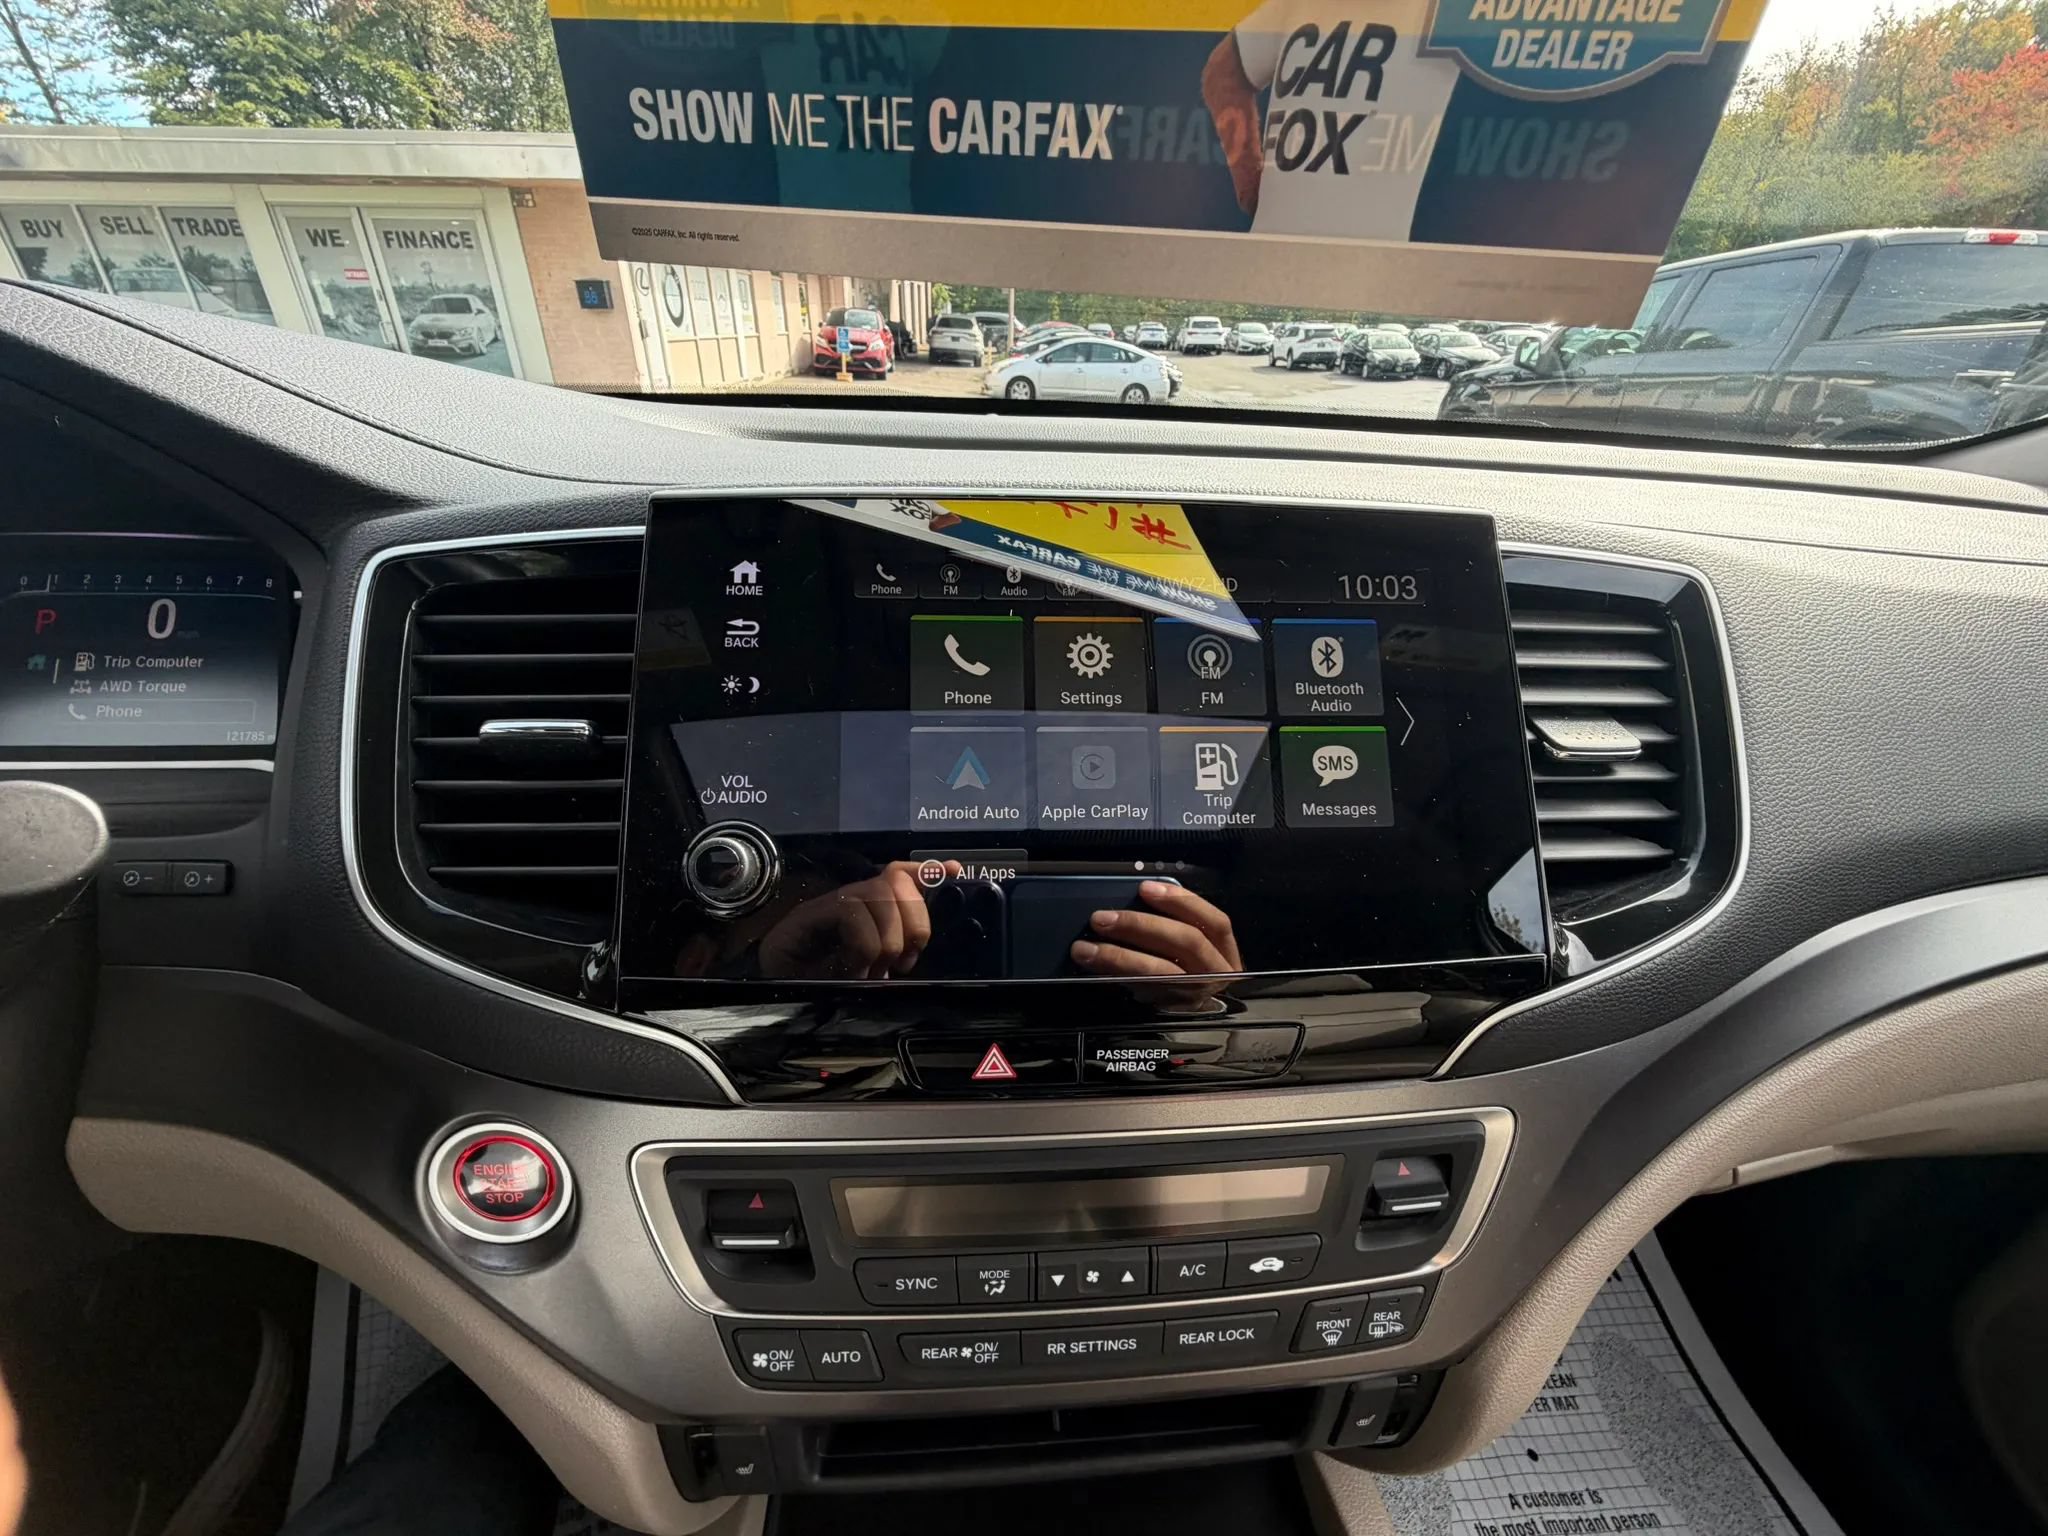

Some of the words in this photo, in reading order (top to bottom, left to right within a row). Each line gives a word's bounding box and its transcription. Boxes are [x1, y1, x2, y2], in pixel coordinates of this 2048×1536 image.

[1469, 0, 1684, 23] ADVANTAGE
[1492, 28, 1634, 71] DEALER
[1276, 21, 1396, 102] CAR
[629, 87, 753, 144] SHOW
[768, 92, 828, 149] ME
[837, 95, 915, 152] THE
[928, 97, 1115, 161] CARFAX
[1262, 110, 1366, 176] FOX
[20, 219, 64, 239] BUY
[100, 216, 154, 236] SELL
[171, 217, 244, 238] TRADE
[305, 228, 345, 248] WE
[382, 230, 474, 250] FINANCE
[20, 576, 28, 586] 0
[83, 574, 91, 584] 2
[115, 574, 122, 584] 3
[145, 575, 152, 584] 4
[176, 575, 183, 585] 5
[206, 576, 213, 585] 6
[236, 576, 243, 585] 7
[265, 578, 273, 588] 8
[1337, 574, 1418, 600] 10:03
[725, 585, 763, 596] HOME
[871, 584, 902, 595] Phone
[943, 585, 958, 595] FM
[1000, 586, 1028, 597] Audio
[35, 608, 57, 634] P
[147, 598, 177, 639] 0
[724, 637, 759, 648] BACK
[103, 655, 131, 669] Trip
[135, 655, 204, 669] Computer
[1200, 666, 1221, 680] FM
[100, 681, 132, 693] AWD
[138, 681, 187, 695] Torque
[1295, 682, 1364, 697] Bluetooth
[944, 690, 992, 705] Phone
[1060, 690, 1123, 707] Settings
[1201, 692, 1224, 705] FM
[96, 705, 143, 718] Phone
[1311, 700, 1352, 712] Audio
[1317, 754, 1354, 772] SMS
[721, 775, 753, 788] VOL
[718, 790, 768, 804] AUDIO
[1203, 794, 1233, 809] Trip
[917, 806, 979, 821] Android
[983, 806, 1020, 820] Auto
[1042, 805, 1086, 822] Apple
[1090, 804, 1149, 821] CarPlay
[1302, 802, 1377, 818] Messages
[1182, 811, 1256, 828] Computer
[956, 866, 975, 879] All
[979, 867, 1016, 884] Apps
[1097, 1048, 1168, 1060] PASSENGER
[1106, 1060, 1155, 1072] AIRBAG
[486, 1192, 524, 1204] STOP
[979, 1270, 1011, 1280] MODE
[1179, 1263, 1207, 1278] A/C
[895, 1277, 938, 1291] SYNC
[1373, 1310, 1401, 1322] REAR
[1316, 1317, 1351, 1331] FRONT
[1179, 1331, 1215, 1345] REAR
[1218, 1327, 1255, 1342] LOCK
[921, 1347, 958, 1360] REAR
[974, 1342, 999, 1353] ON/
[1047, 1342, 1066, 1355] RR
[1069, 1338, 1137, 1353] SETTINGS
[769, 1349, 794, 1361] ON/
[821, 1351, 861, 1364] AUTO
[974, 1353, 999, 1364] OFF
[769, 1360, 795, 1373] OFF
[1551, 1395, 1580, 1411] MAT
[1508, 1493, 1521, 1510] A
[1522, 1490, 1586, 1509] customer
[1586, 1488, 1604, 1505] is
[1474, 1521, 1500, 1536] the
[1501, 1517, 1540, 1536] most
[1541, 1513, 1610, 1536] important
[1613, 1511, 1662, 1533] person
